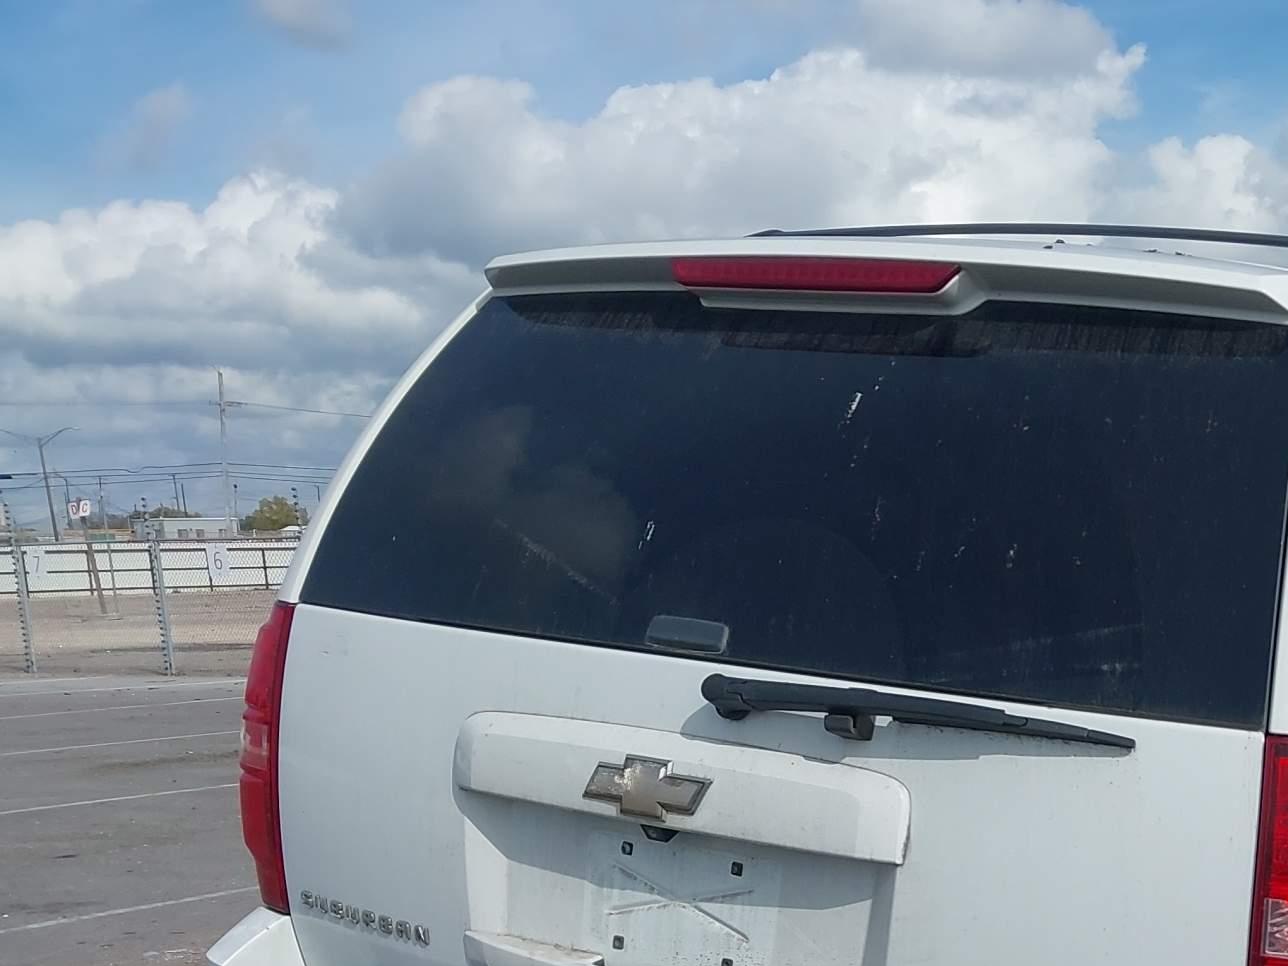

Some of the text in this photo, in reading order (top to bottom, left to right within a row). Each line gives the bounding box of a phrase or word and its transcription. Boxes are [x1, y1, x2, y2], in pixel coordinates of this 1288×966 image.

[70, 503, 78, 516] D
[80, 502, 88, 514] C
[32, 555, 40, 574] 7
[213, 551, 223, 571] 6
[300, 890, 431, 946] SUBURBAN
